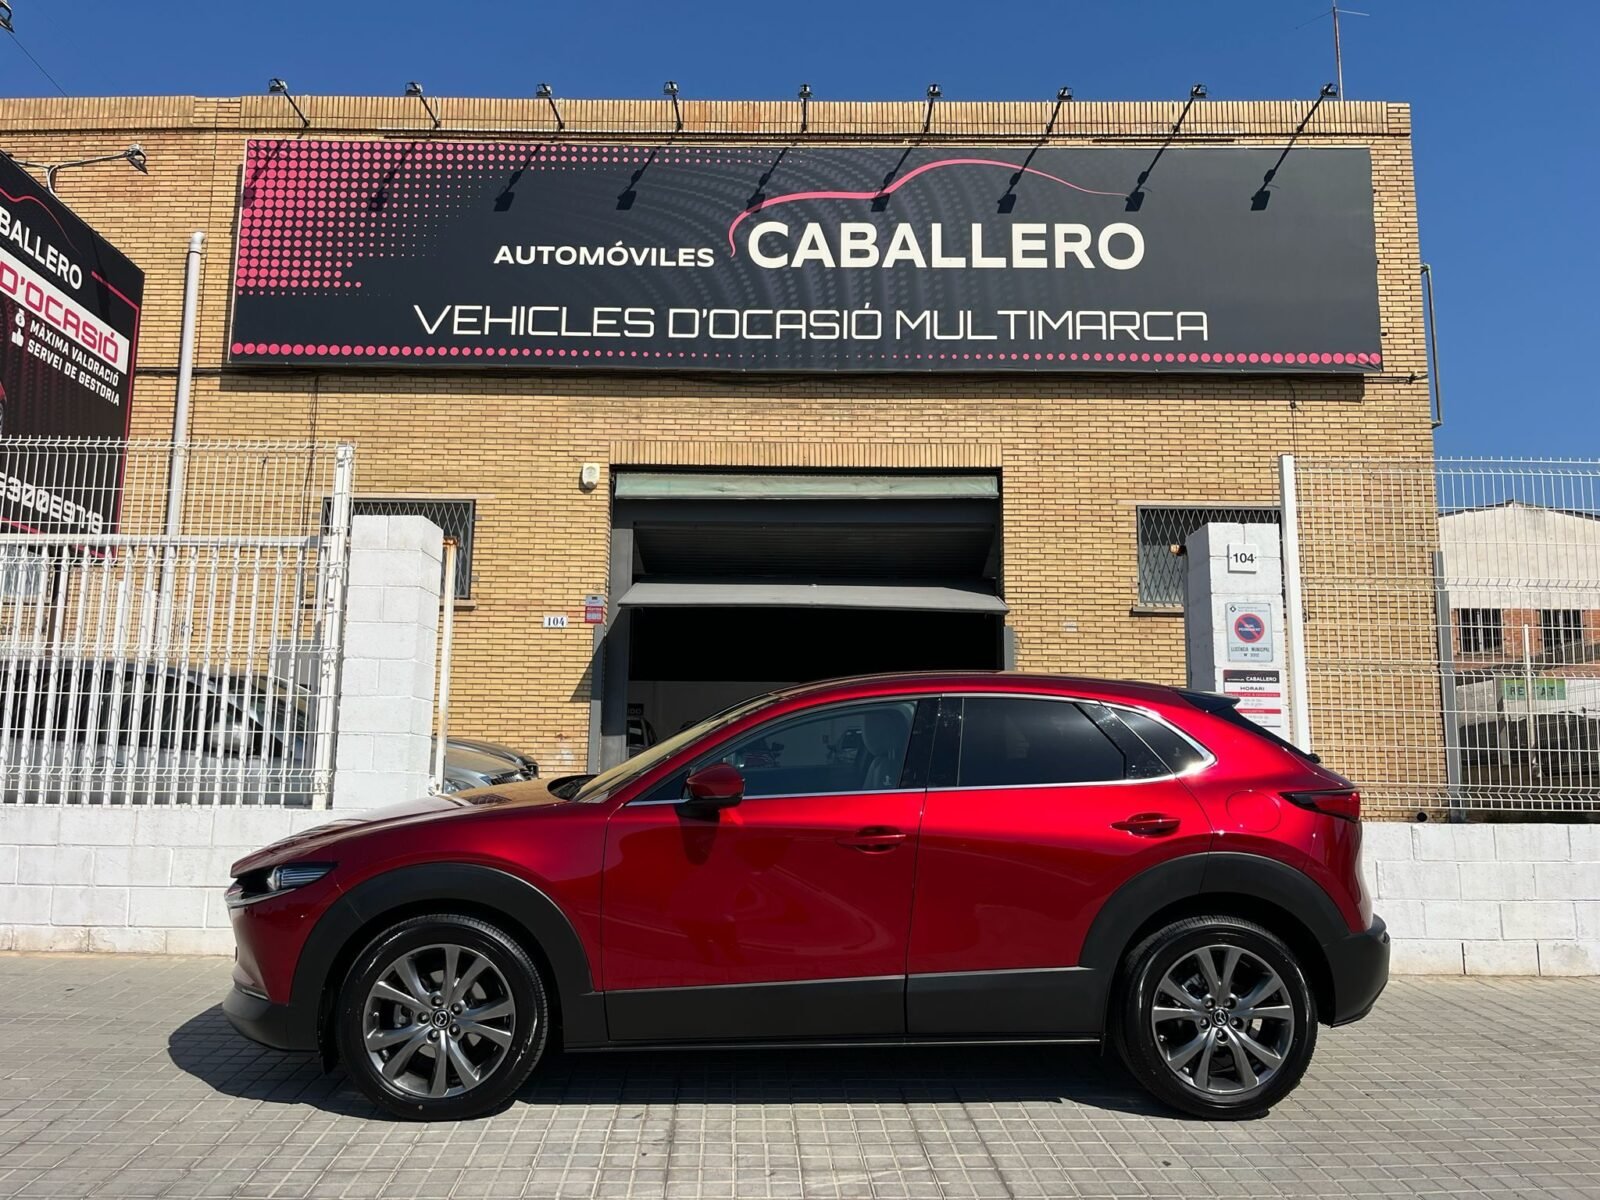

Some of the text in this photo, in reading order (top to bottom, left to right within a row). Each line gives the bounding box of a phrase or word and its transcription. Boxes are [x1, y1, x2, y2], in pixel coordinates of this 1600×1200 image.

[493, 221, 1145, 270] AUTOMÓVILES CABALLERO
[413, 302, 1208, 341] VEHICLES D'OCASIÓ MULTIMARCA
[27, 339, 120, 406] SERVEI DE GESTORIA
[30, 320, 119, 387] MÀXIMA VALORACIÓ
[1233, 552, 1254, 563] 104
[547, 617, 565, 626] 104
[1511, 686, 1555, 696] REAT
